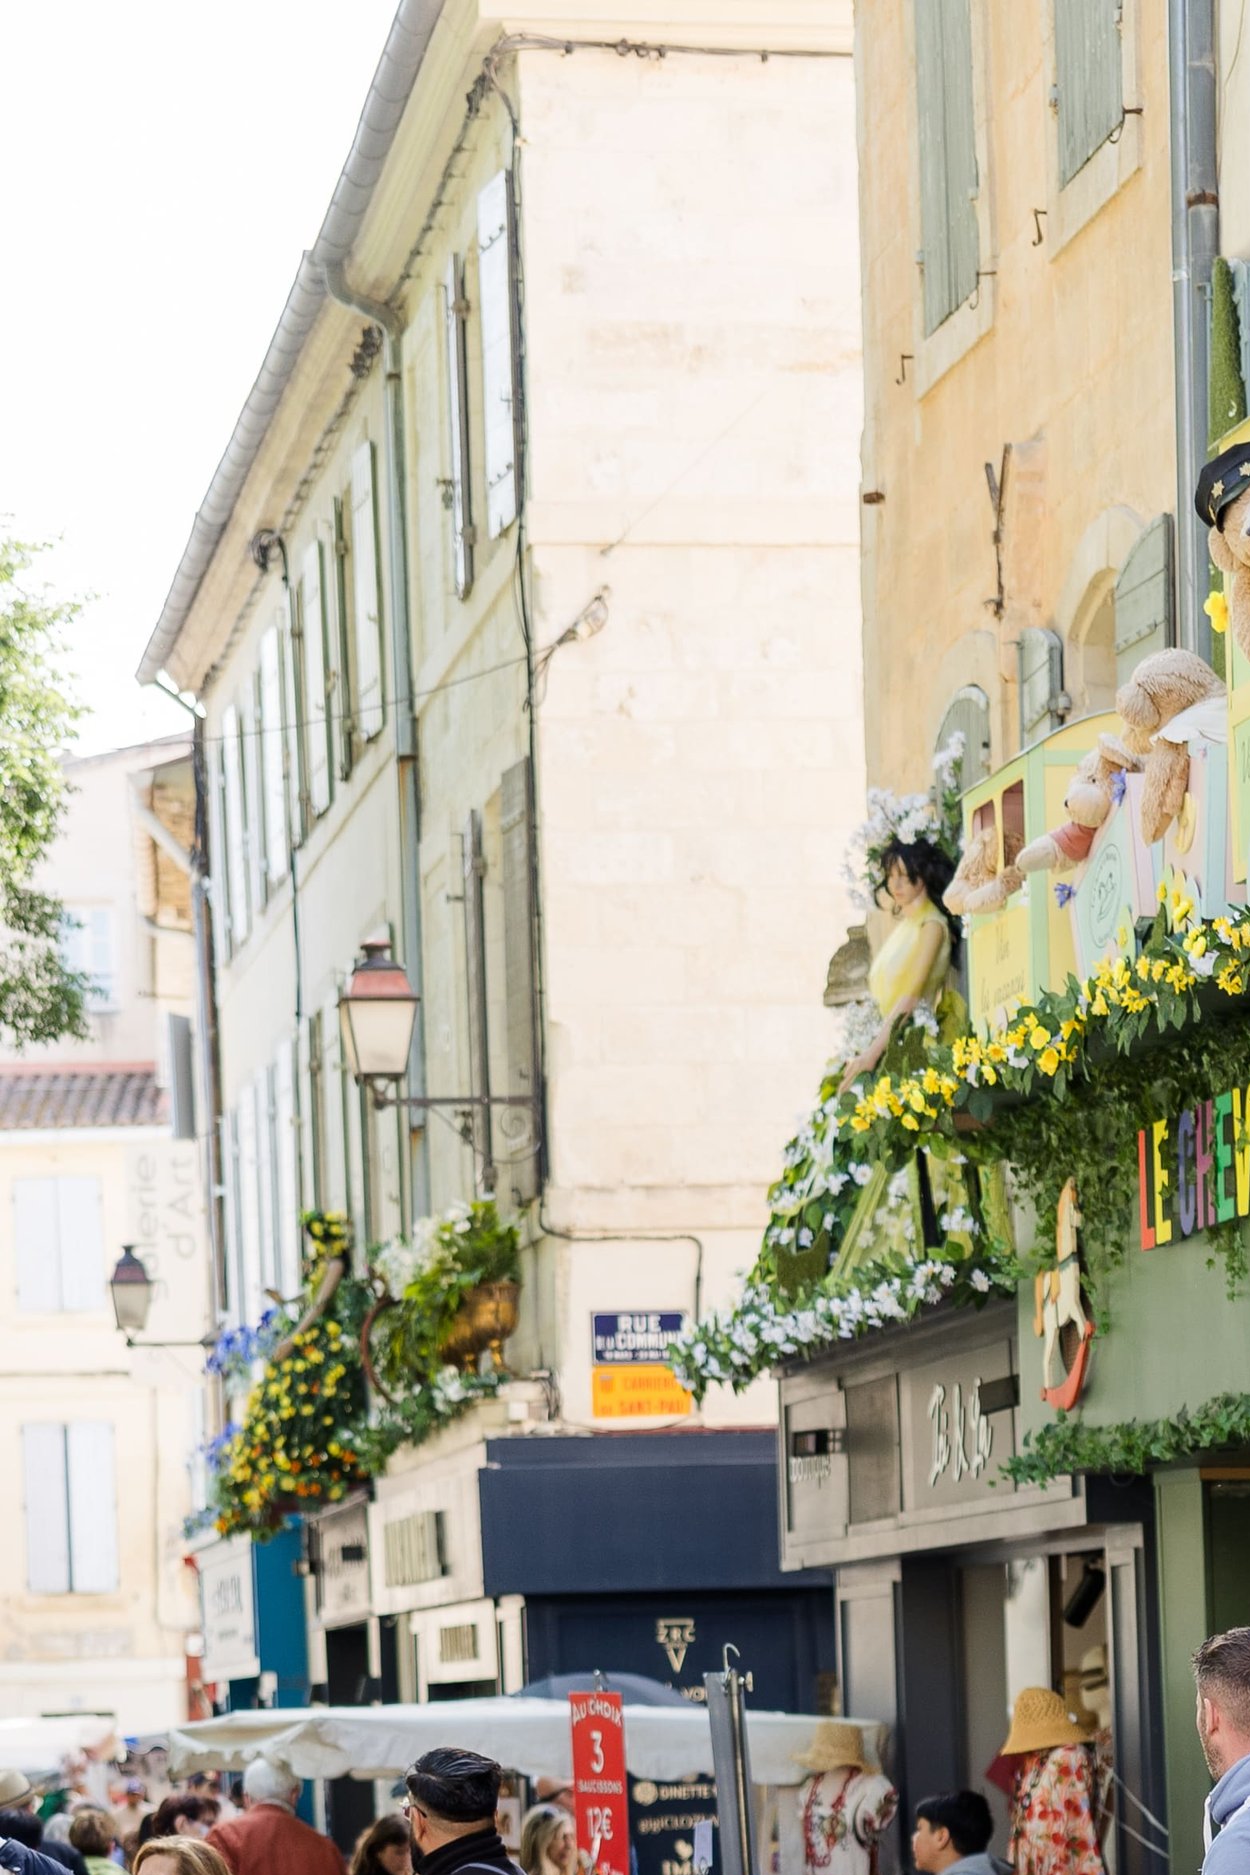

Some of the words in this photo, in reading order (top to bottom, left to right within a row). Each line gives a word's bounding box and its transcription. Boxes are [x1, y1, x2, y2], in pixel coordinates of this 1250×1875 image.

[1138, 1118, 1173, 1250] LE
[616, 1314, 662, 1333] RUE
[615, 1331, 680, 1350] COMMUN
[572, 1701, 587, 1728] AU
[589, 1699, 623, 1728] CHOIX
[590, 1730, 605, 1774] 3
[577, 1779, 623, 1795] SAUCISSONS
[586, 1806, 614, 1841] 12€
